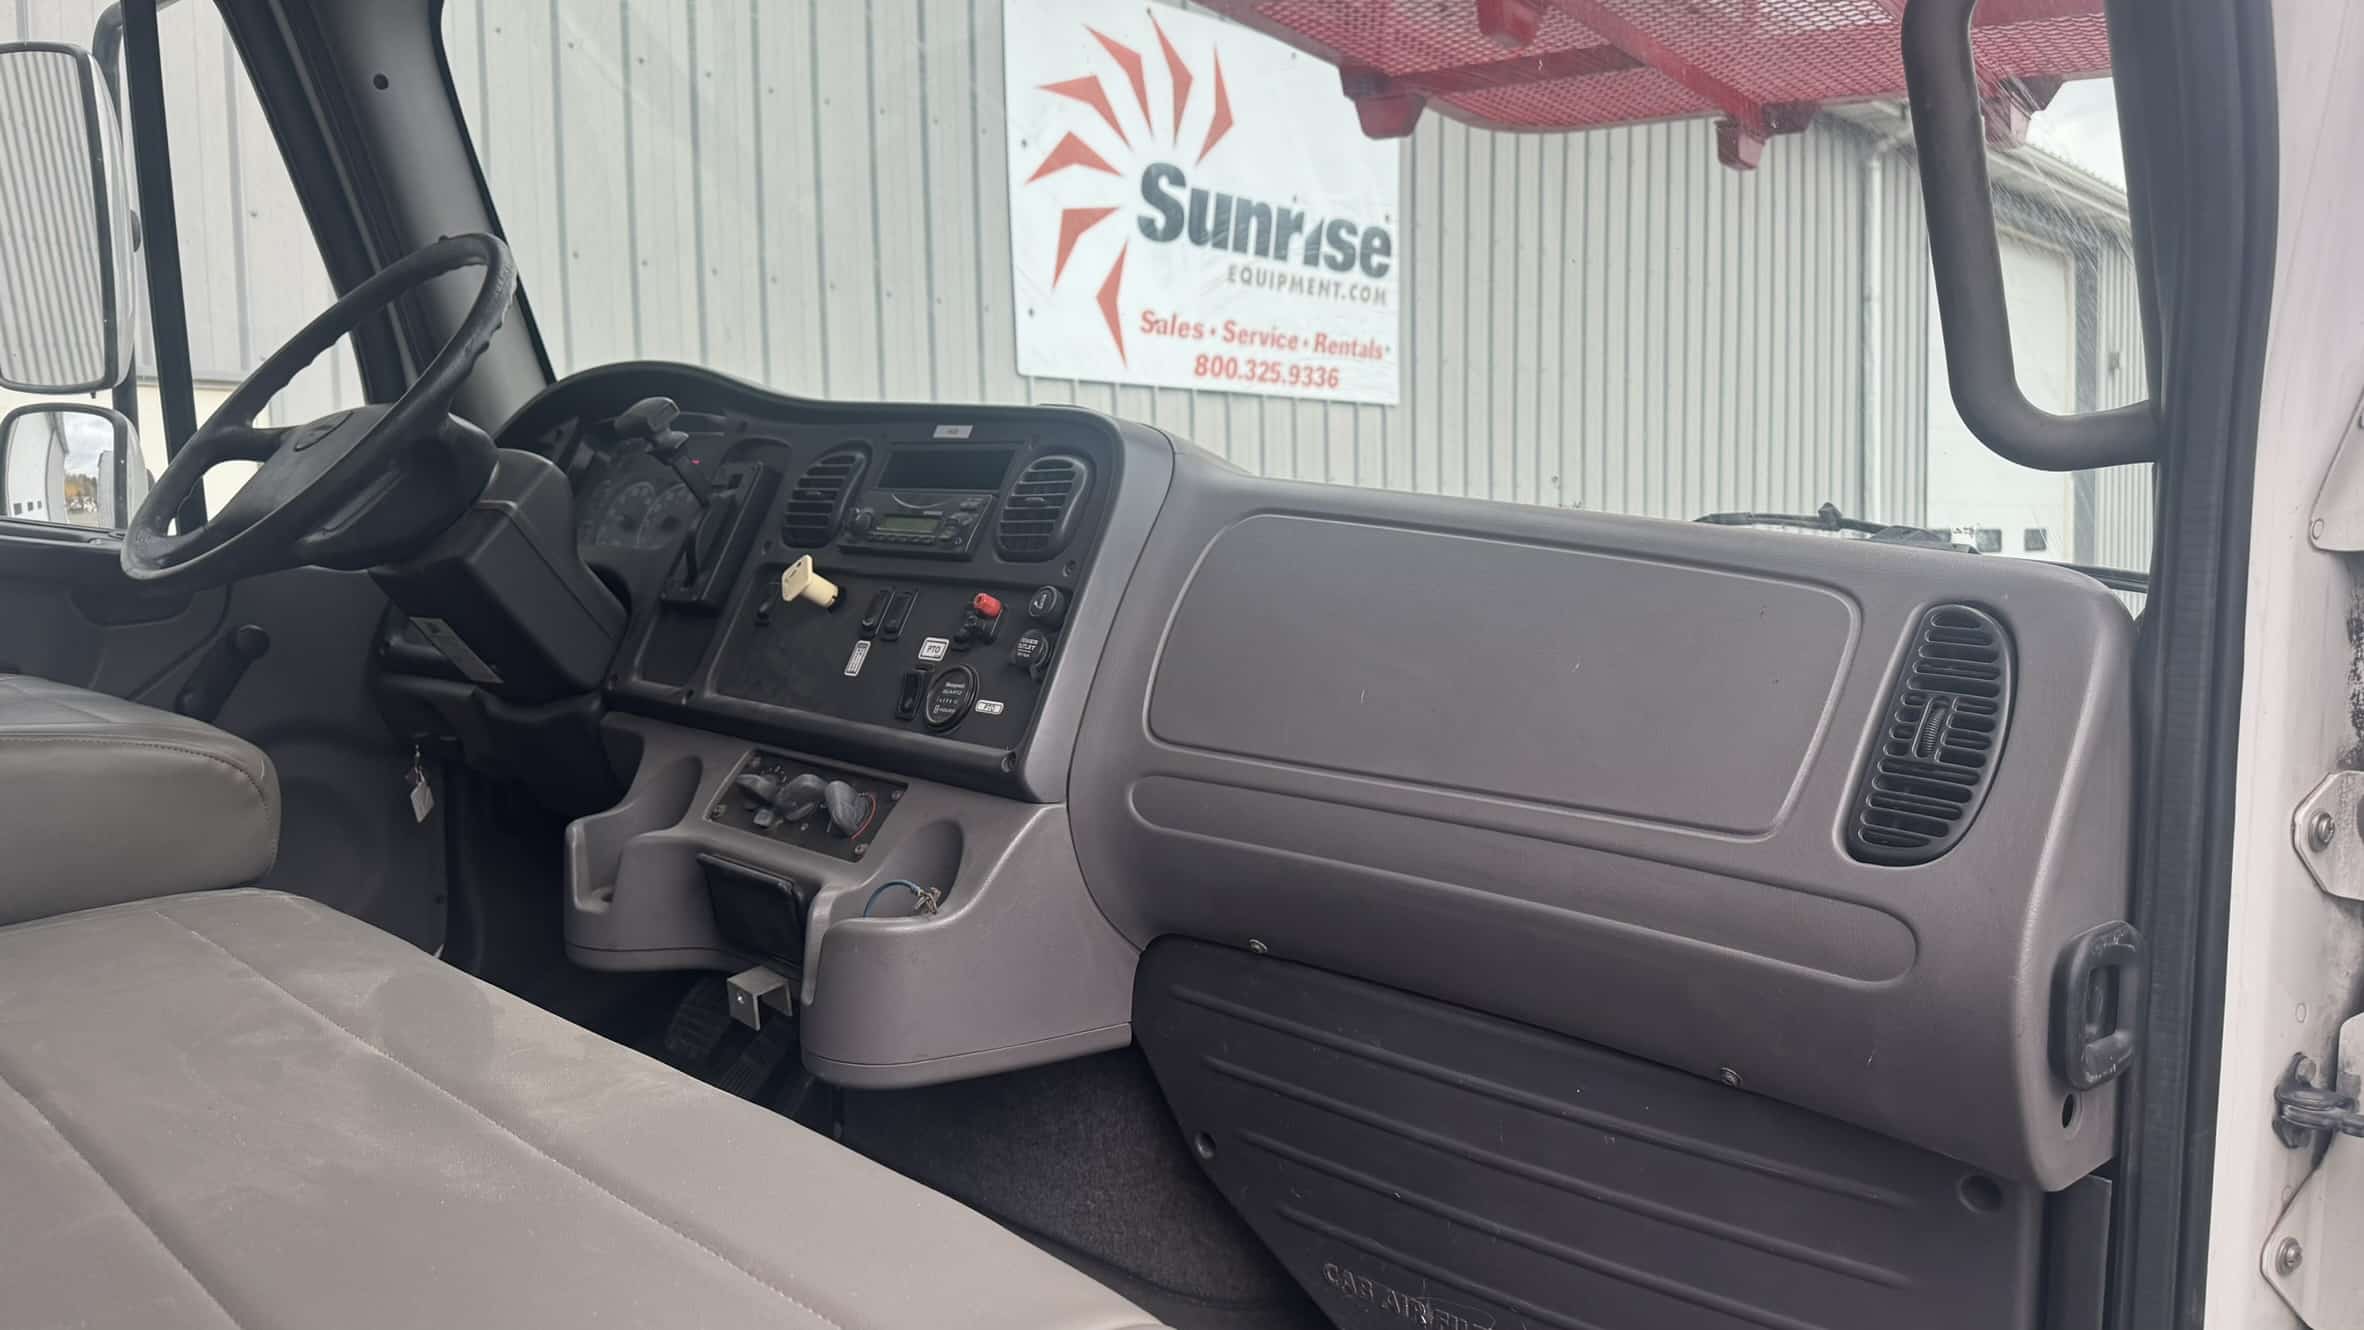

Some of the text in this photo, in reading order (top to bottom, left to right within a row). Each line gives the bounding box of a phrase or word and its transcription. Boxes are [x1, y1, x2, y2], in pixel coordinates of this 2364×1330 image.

[1137, 162, 1392, 279] Sunrise
[1227, 263, 1387, 306] EQUIPMENT.COM
[1140, 308, 1384, 361] Sales Service Rentals
[1194, 353, 1340, 389] 800.325.9336
[926, 645, 941, 654] PTO
